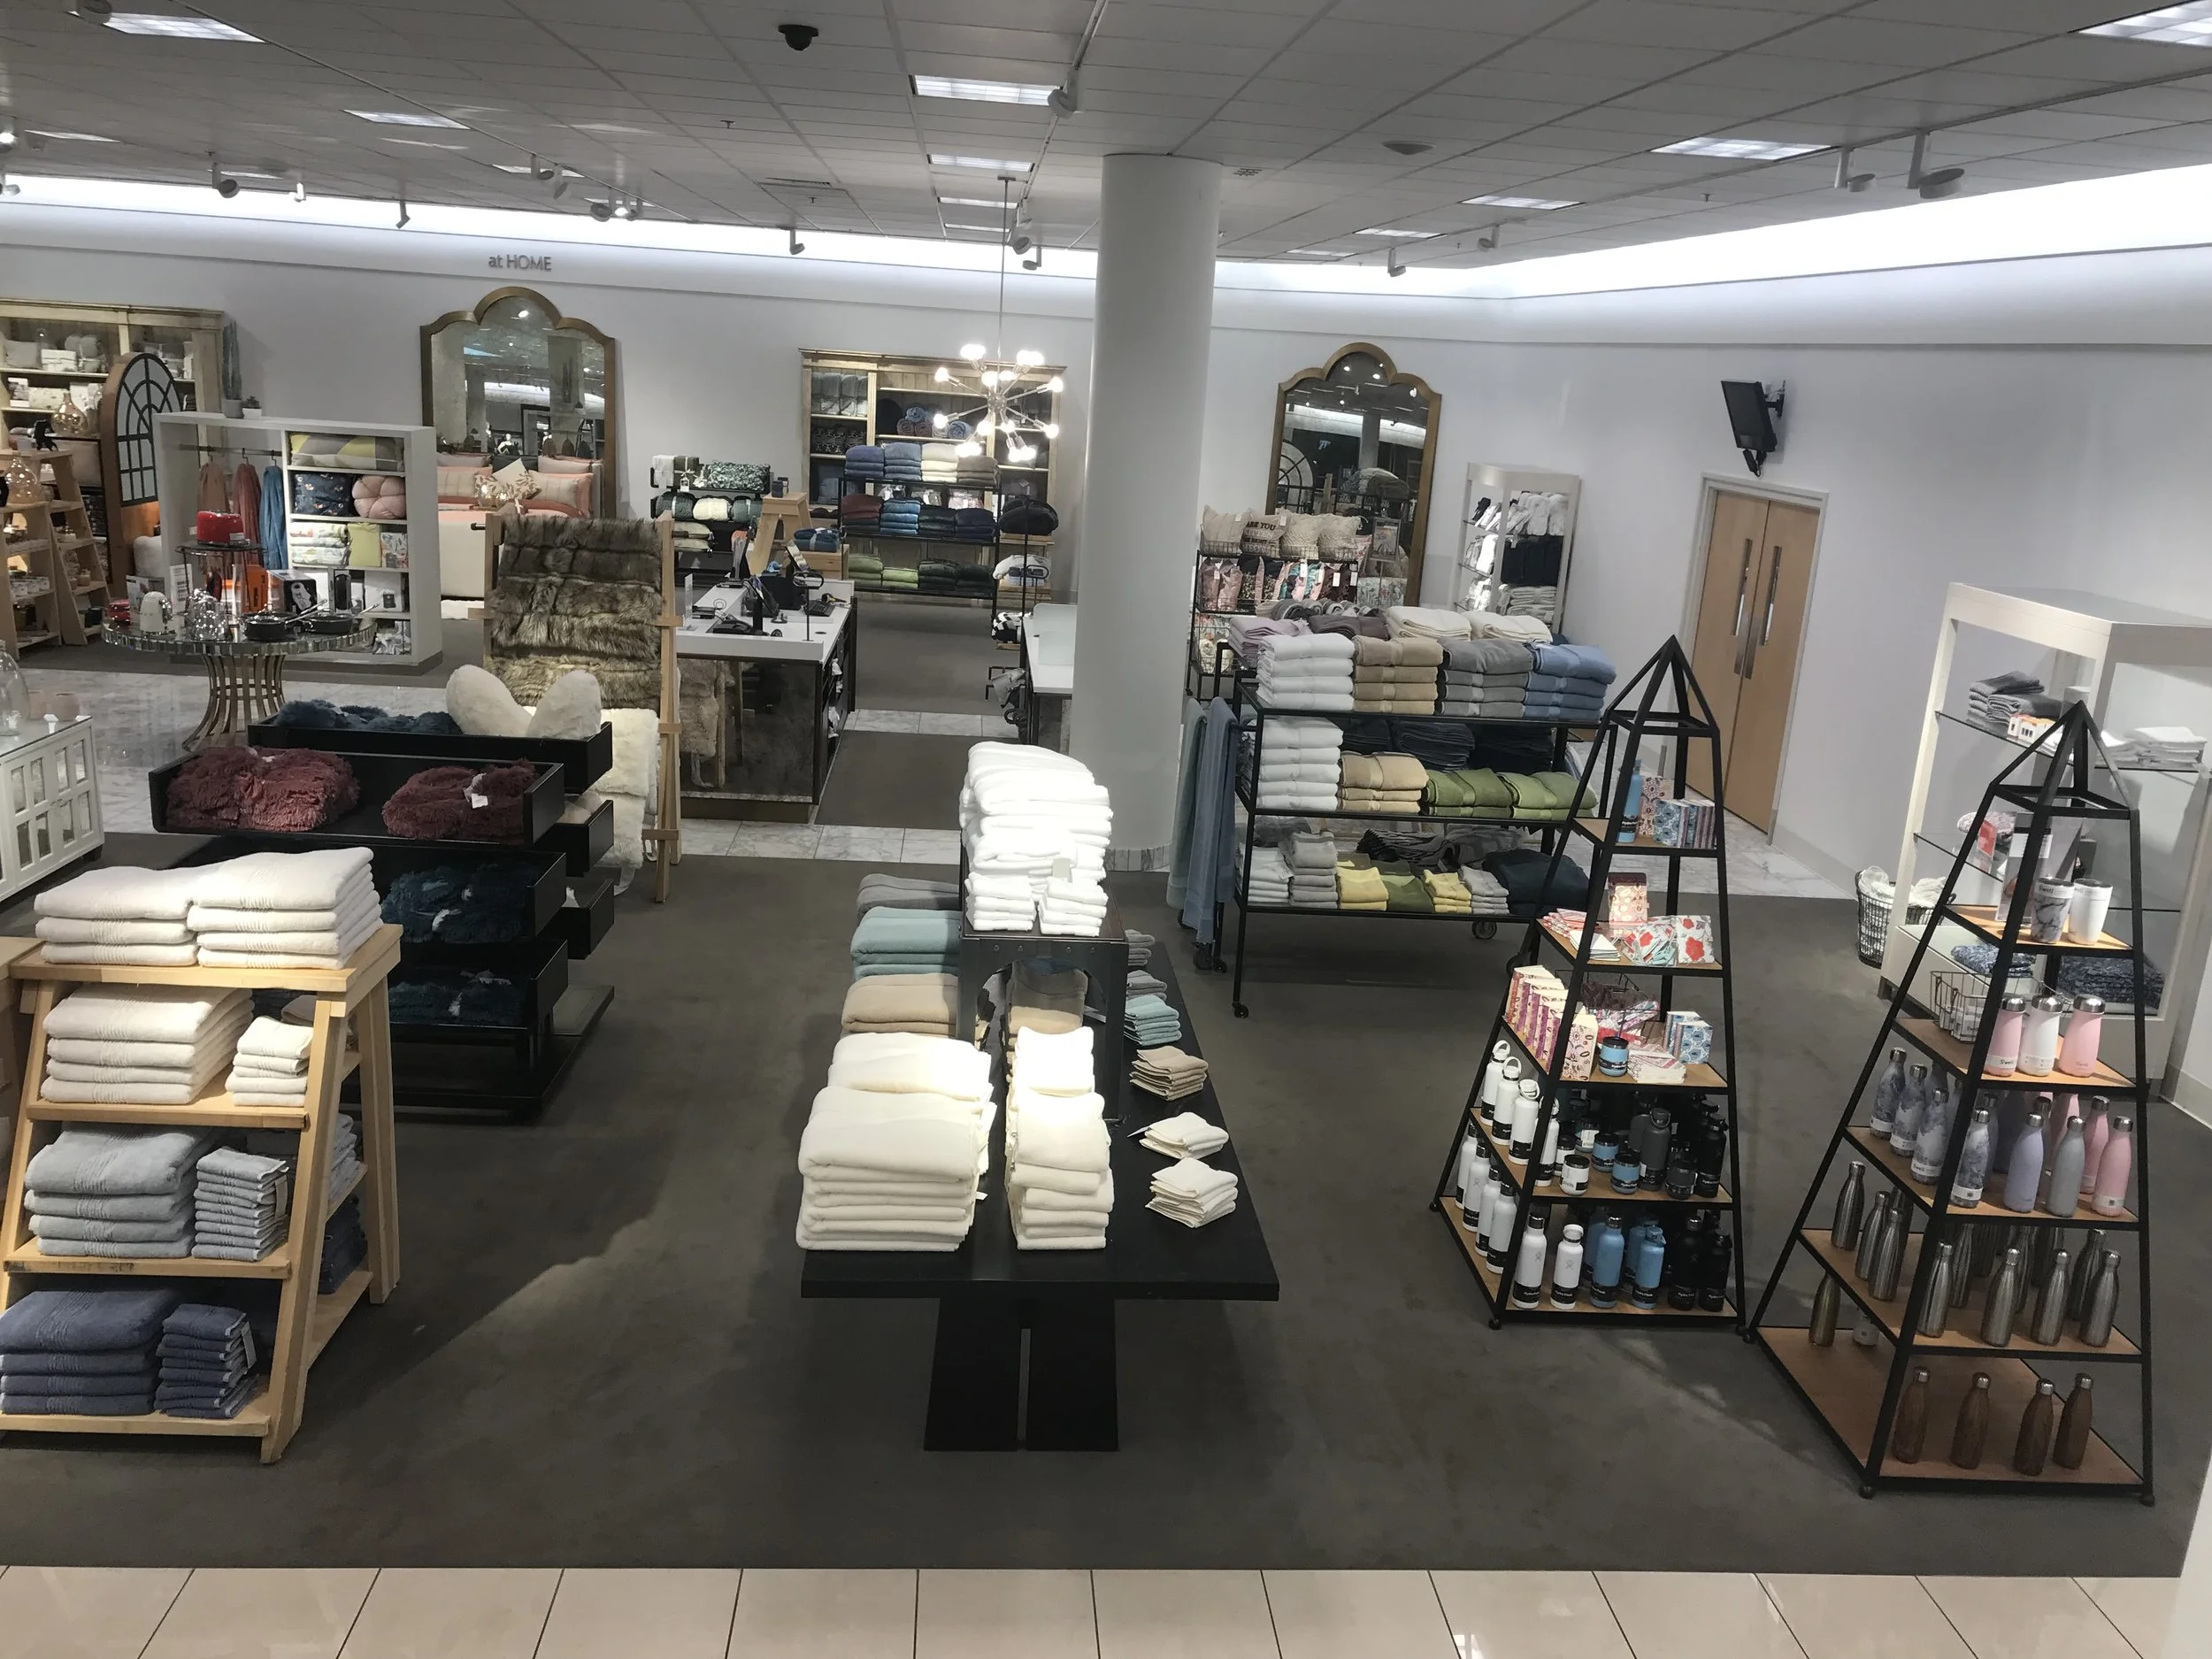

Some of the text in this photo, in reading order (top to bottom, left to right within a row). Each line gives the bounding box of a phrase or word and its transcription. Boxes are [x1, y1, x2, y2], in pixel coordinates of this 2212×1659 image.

[488, 254, 552, 272] at HOME
[1260, 522, 1276, 531] YOU
